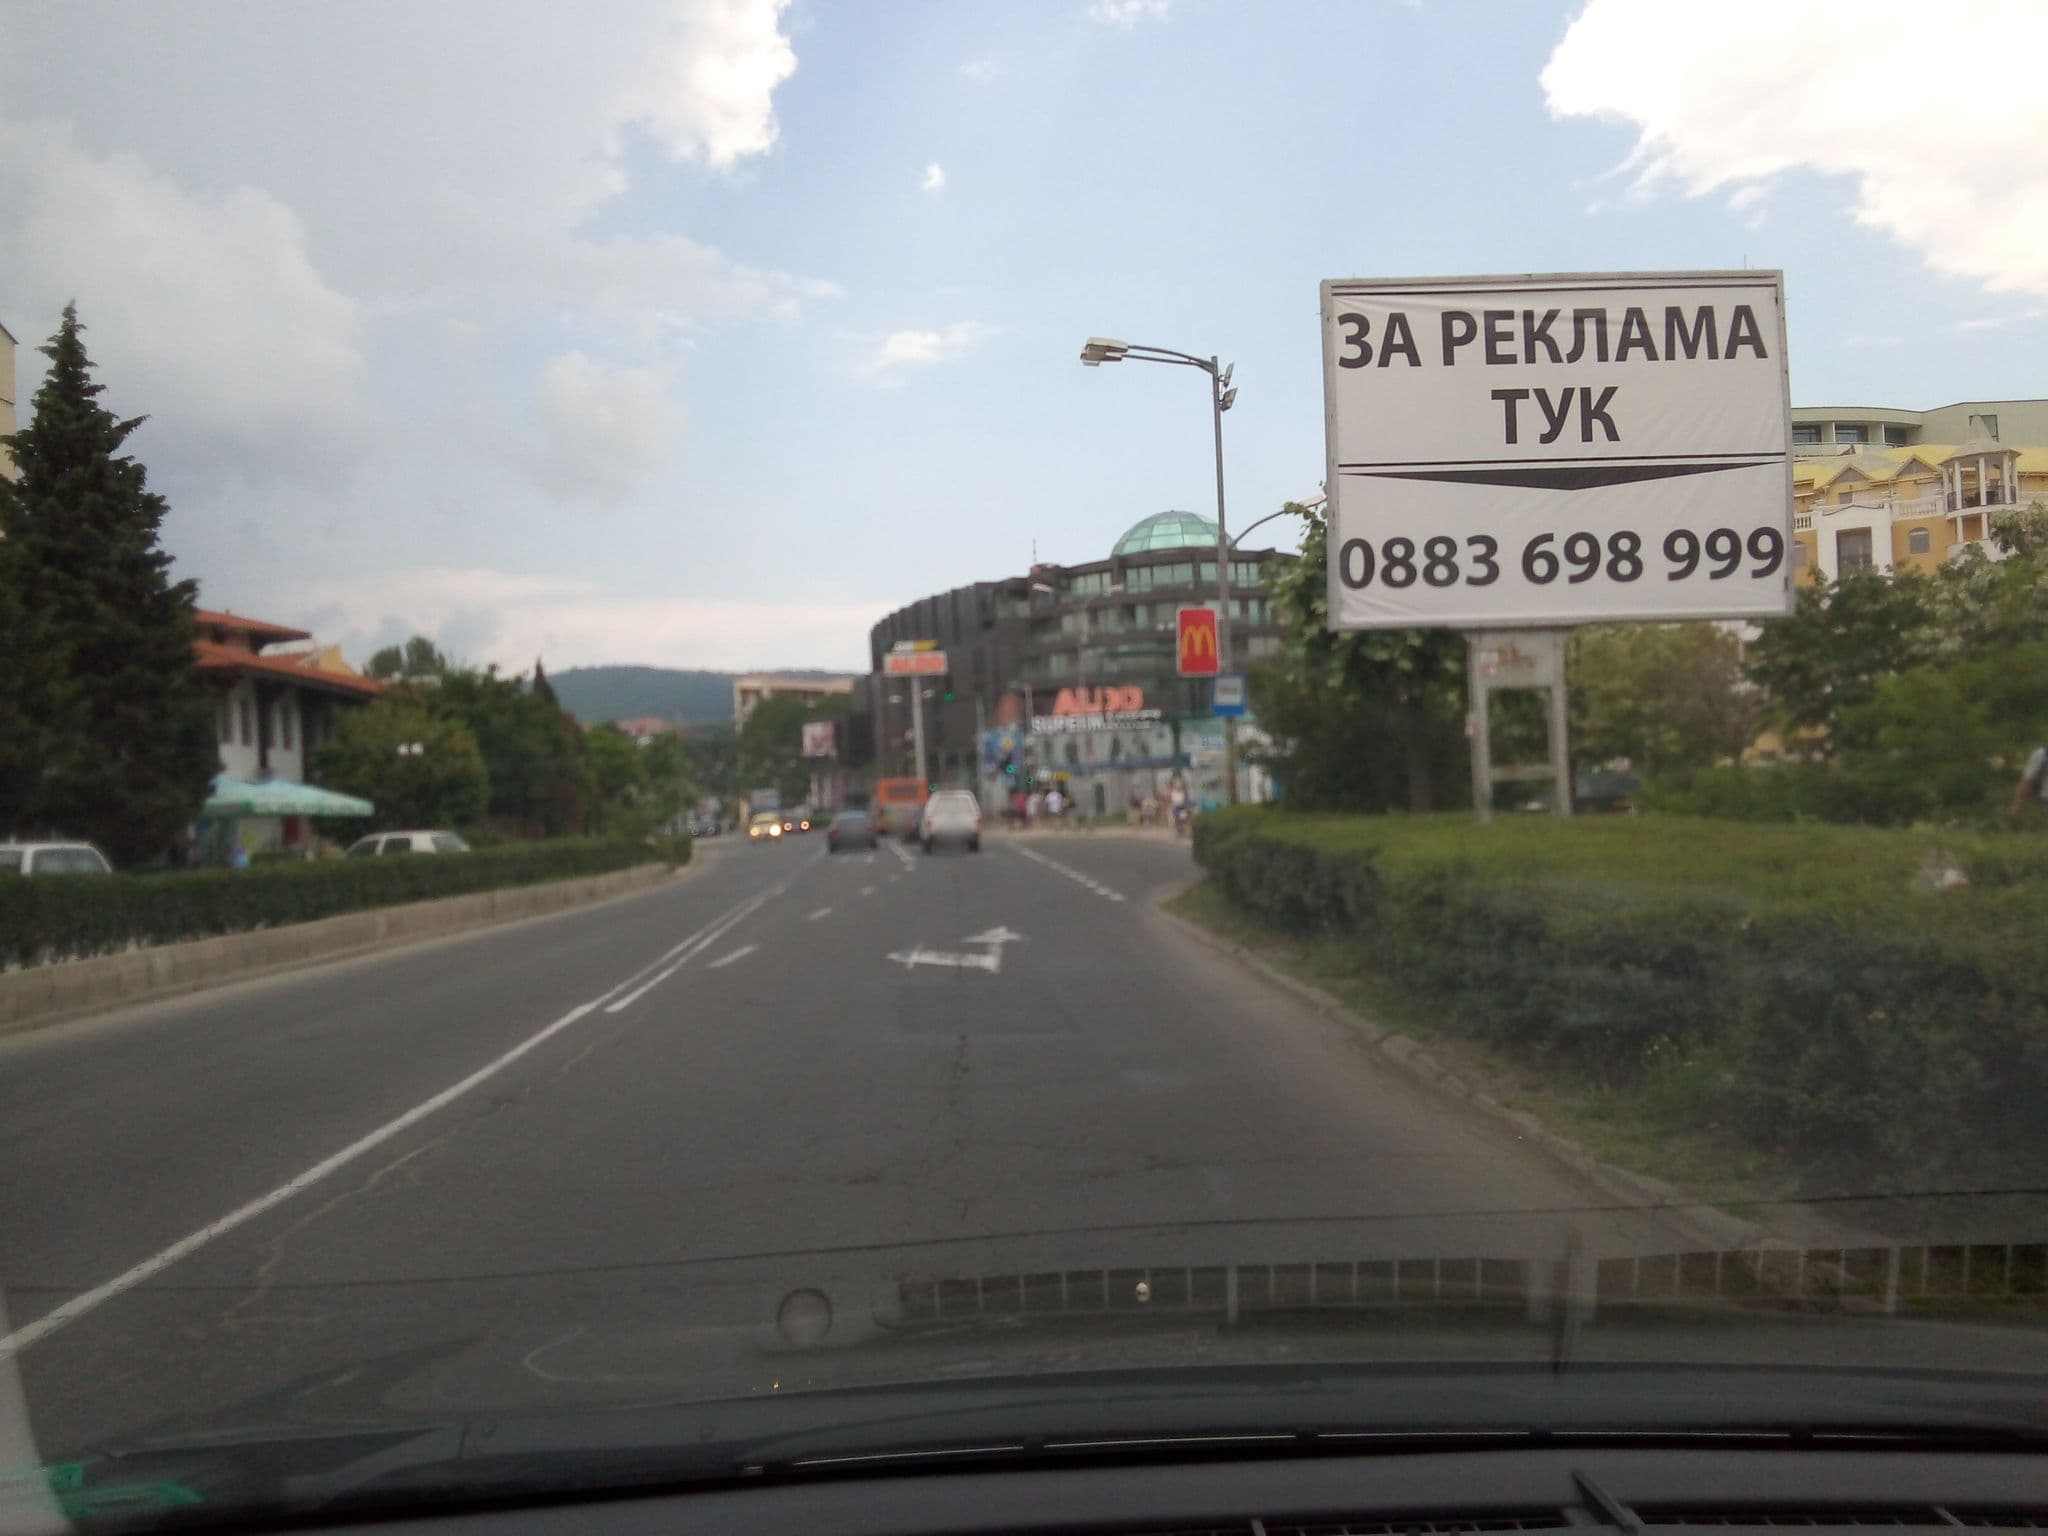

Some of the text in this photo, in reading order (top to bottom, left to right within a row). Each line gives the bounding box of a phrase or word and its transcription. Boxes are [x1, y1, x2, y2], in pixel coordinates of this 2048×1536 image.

[1337, 304, 1768, 369] ЗА РЕКЛАМА
[1491, 386, 1621, 445] ТУК
[1339, 526, 1785, 590] 0883 698 999
